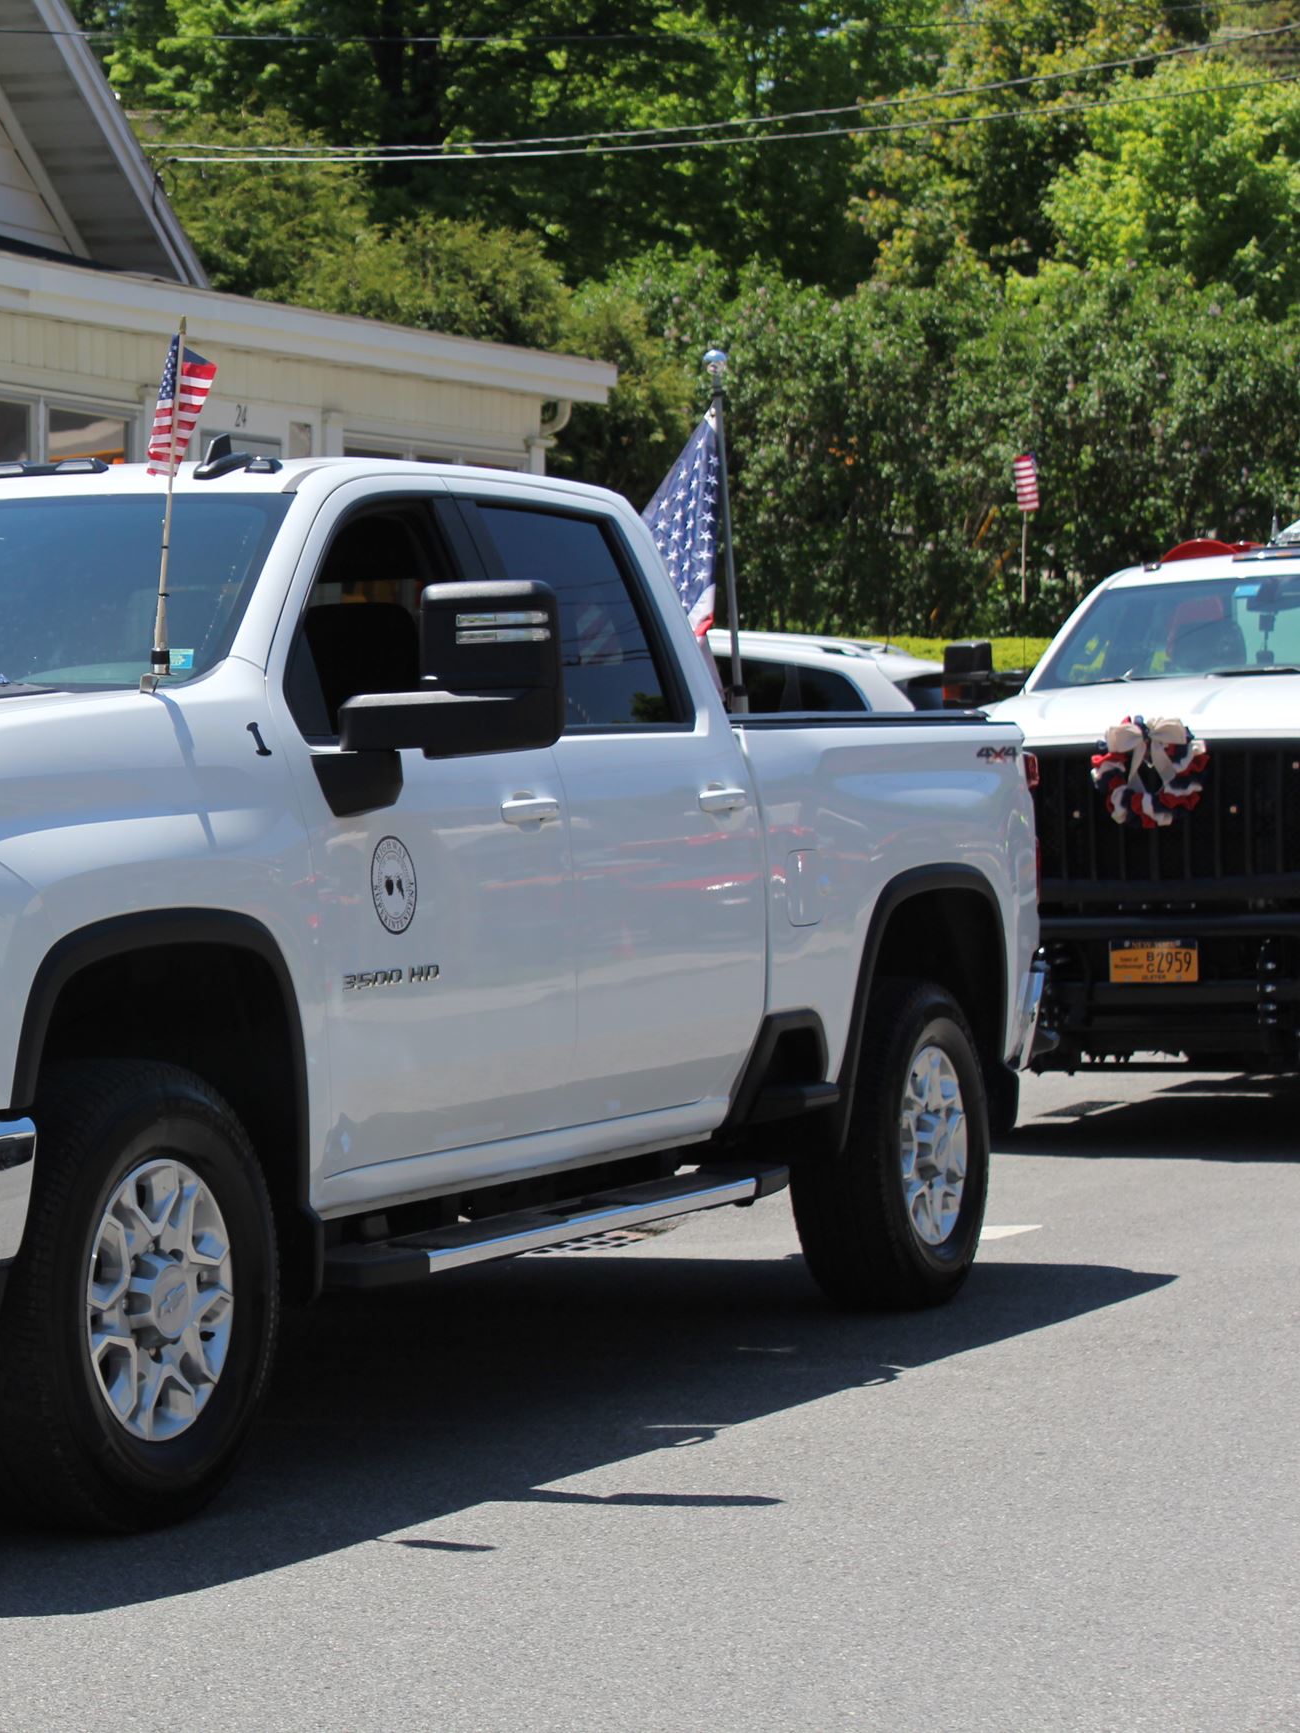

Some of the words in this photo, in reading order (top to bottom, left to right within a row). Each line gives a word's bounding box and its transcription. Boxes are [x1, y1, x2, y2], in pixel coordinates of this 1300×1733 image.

[235, 404, 247, 428] 24
[375, 841, 407, 863] HIGHWAY
[1156, 952, 1192, 973] 2959
[342, 968, 403, 993] 3500
[409, 964, 440, 983] HD
